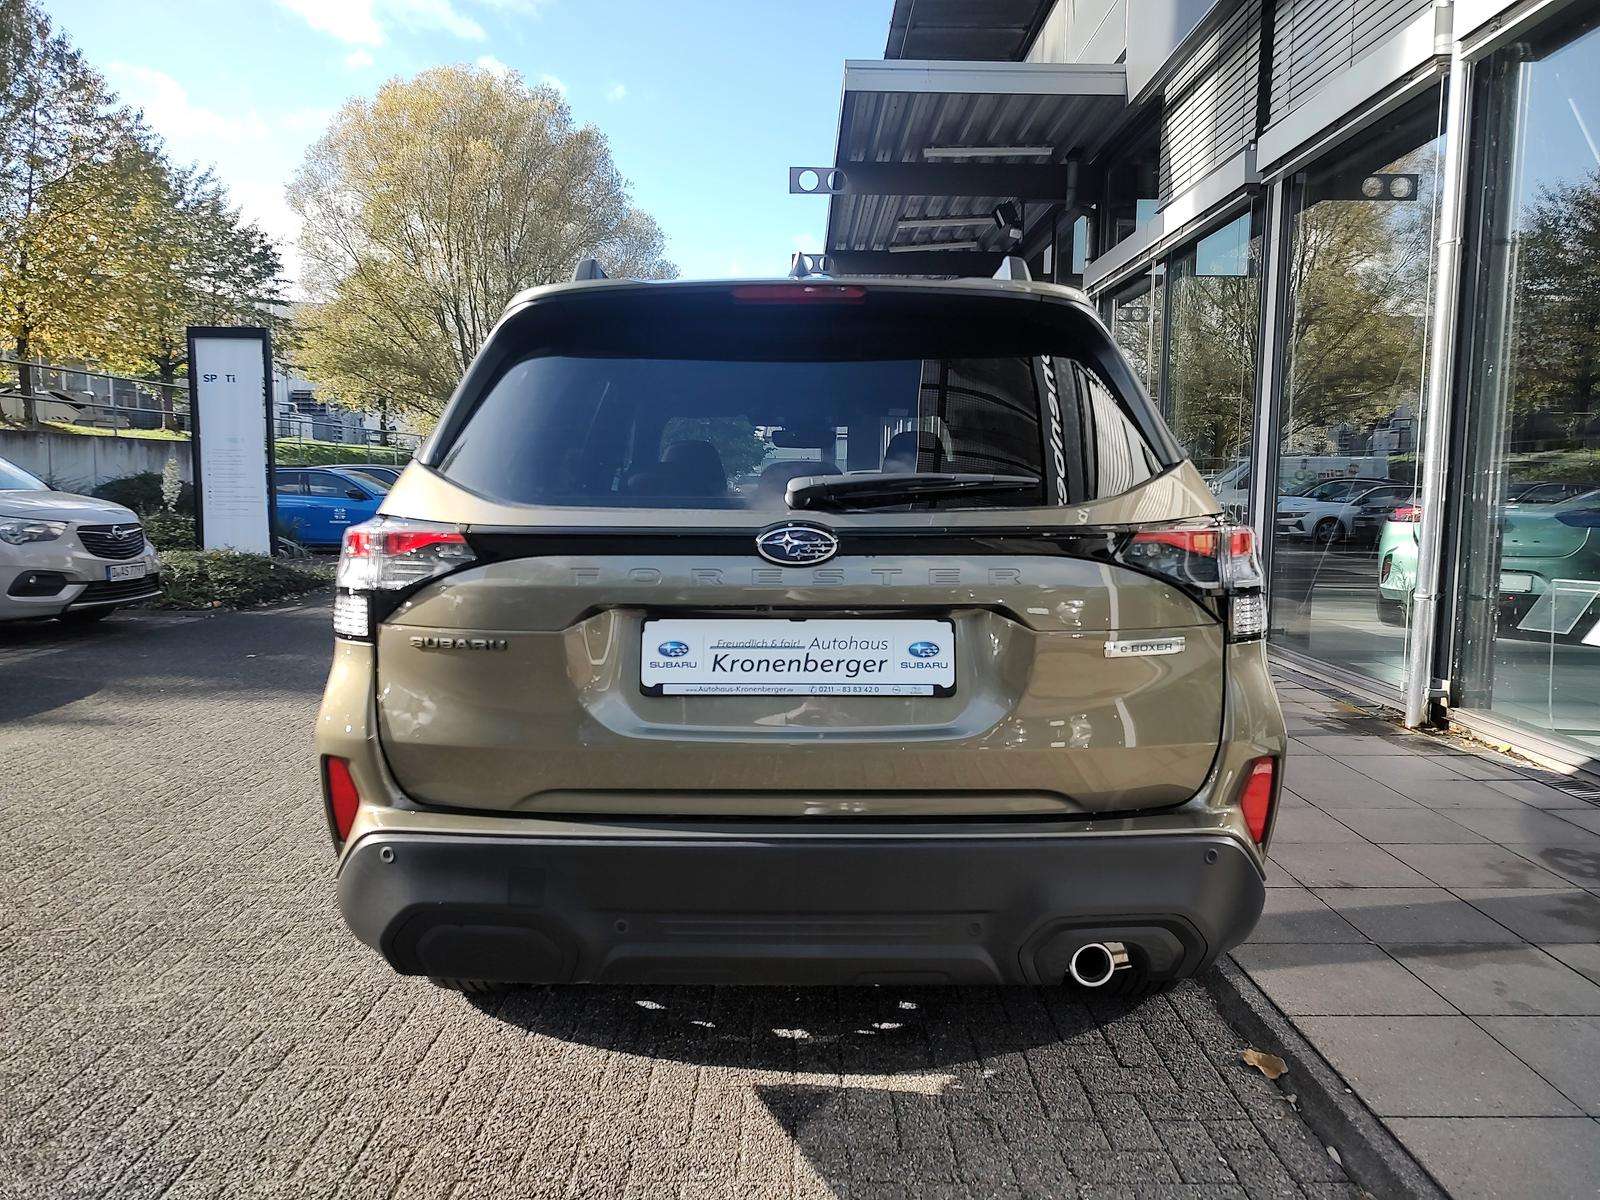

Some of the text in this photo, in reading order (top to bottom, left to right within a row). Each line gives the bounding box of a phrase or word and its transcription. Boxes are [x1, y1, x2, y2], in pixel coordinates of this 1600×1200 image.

[569, 566, 1023, 587] FORESTER
[408, 637, 508, 650] SUBARU
[716, 639, 768, 649] Freundlich
[770, 639, 777, 649] &
[809, 636, 888, 651] Autohaus
[1120, 643, 1173, 653] e-BOXER
[649, 661, 698, 669] SUBARU
[711, 652, 888, 678] Kronenberger
[900, 661, 949, 669] SUBARU
